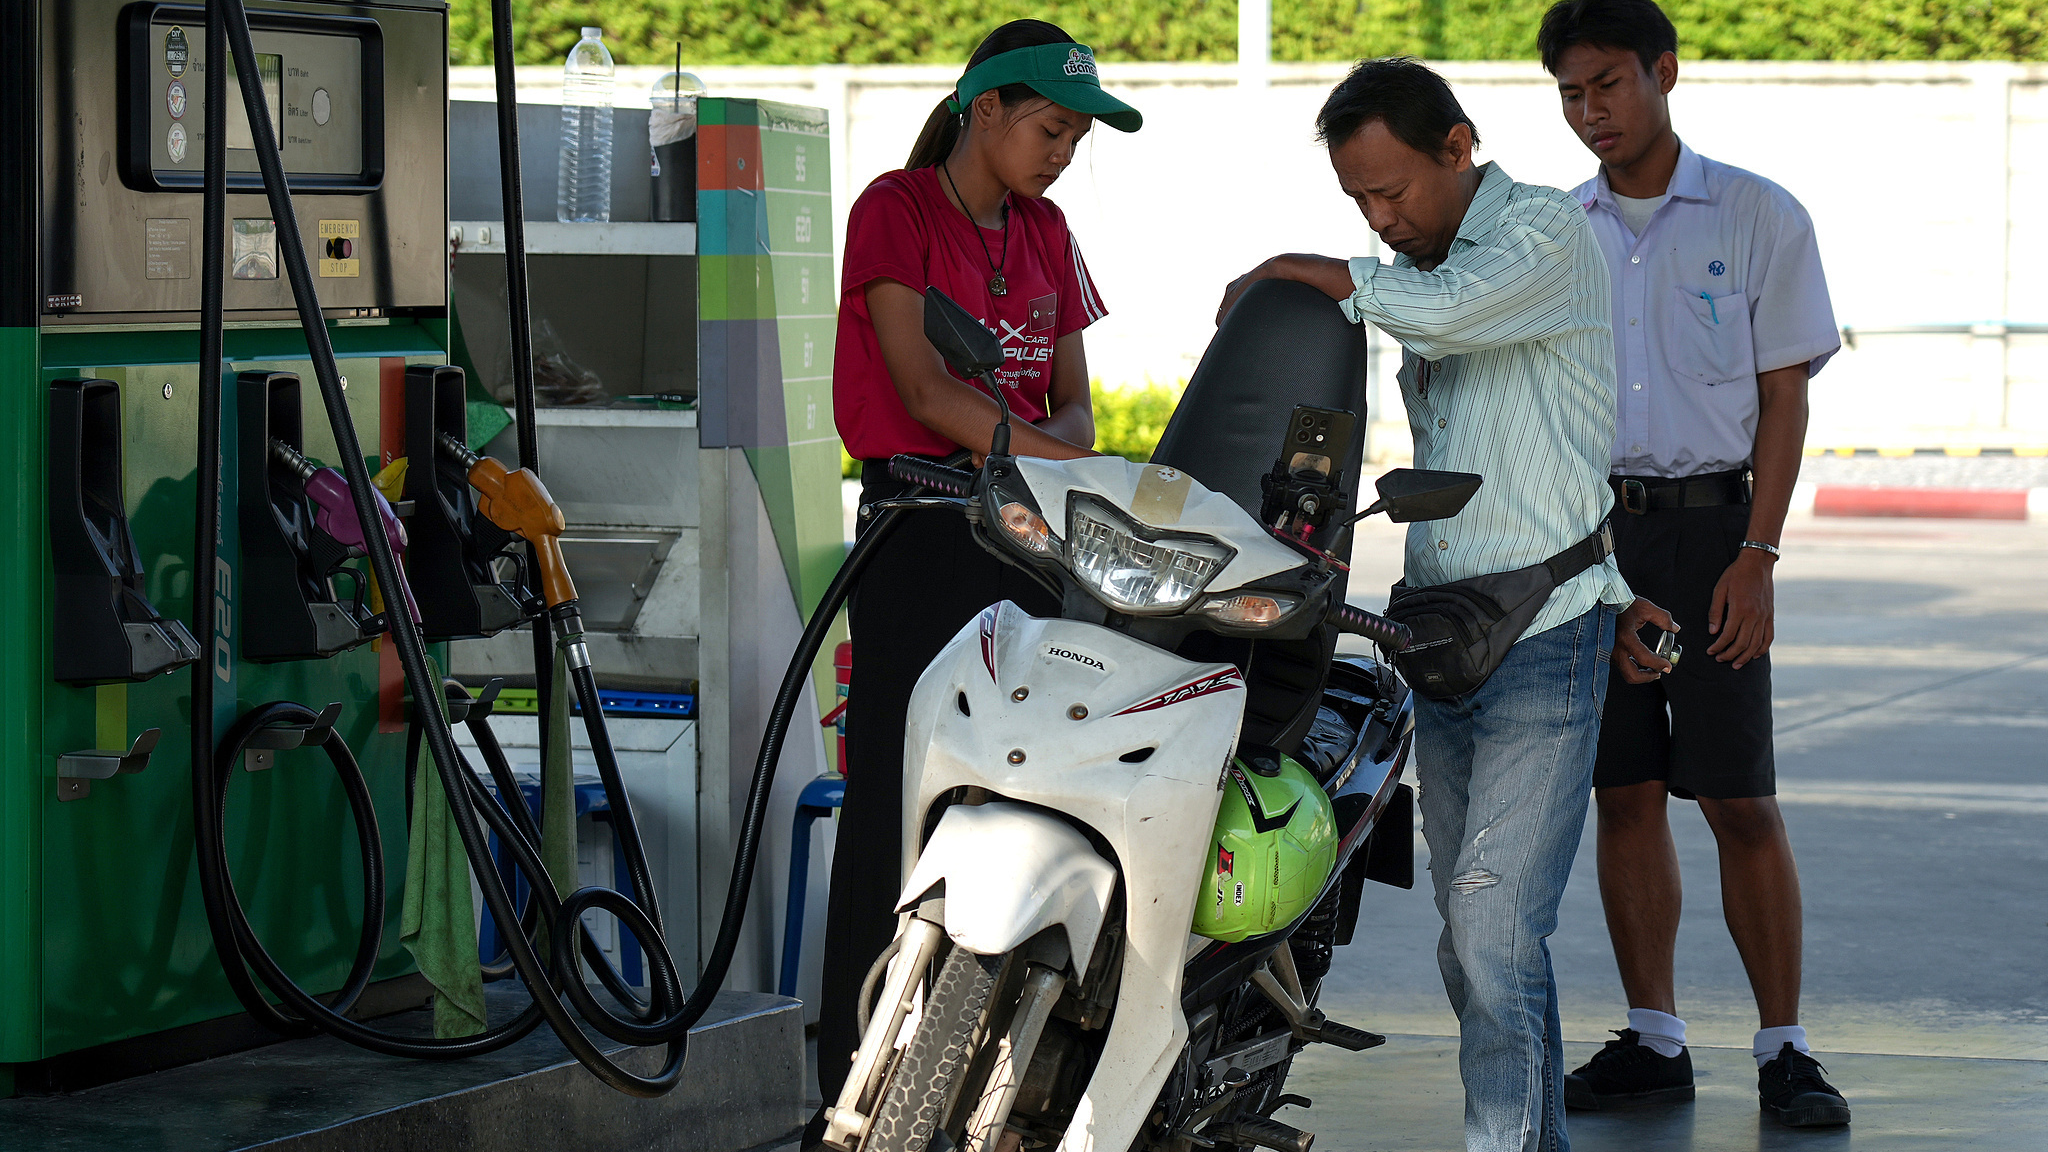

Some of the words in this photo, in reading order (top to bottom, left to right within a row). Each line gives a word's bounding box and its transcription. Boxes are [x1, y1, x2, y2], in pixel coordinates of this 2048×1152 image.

[320, 223, 358, 234] EMERGENCY
[330, 262, 348, 273] STOP
[1024, 335, 1049, 345] CARD
[215, 556, 232, 683] E20
[1048, 647, 1106, 672] HONDA
[1235, 884, 1243, 904] INDEX
